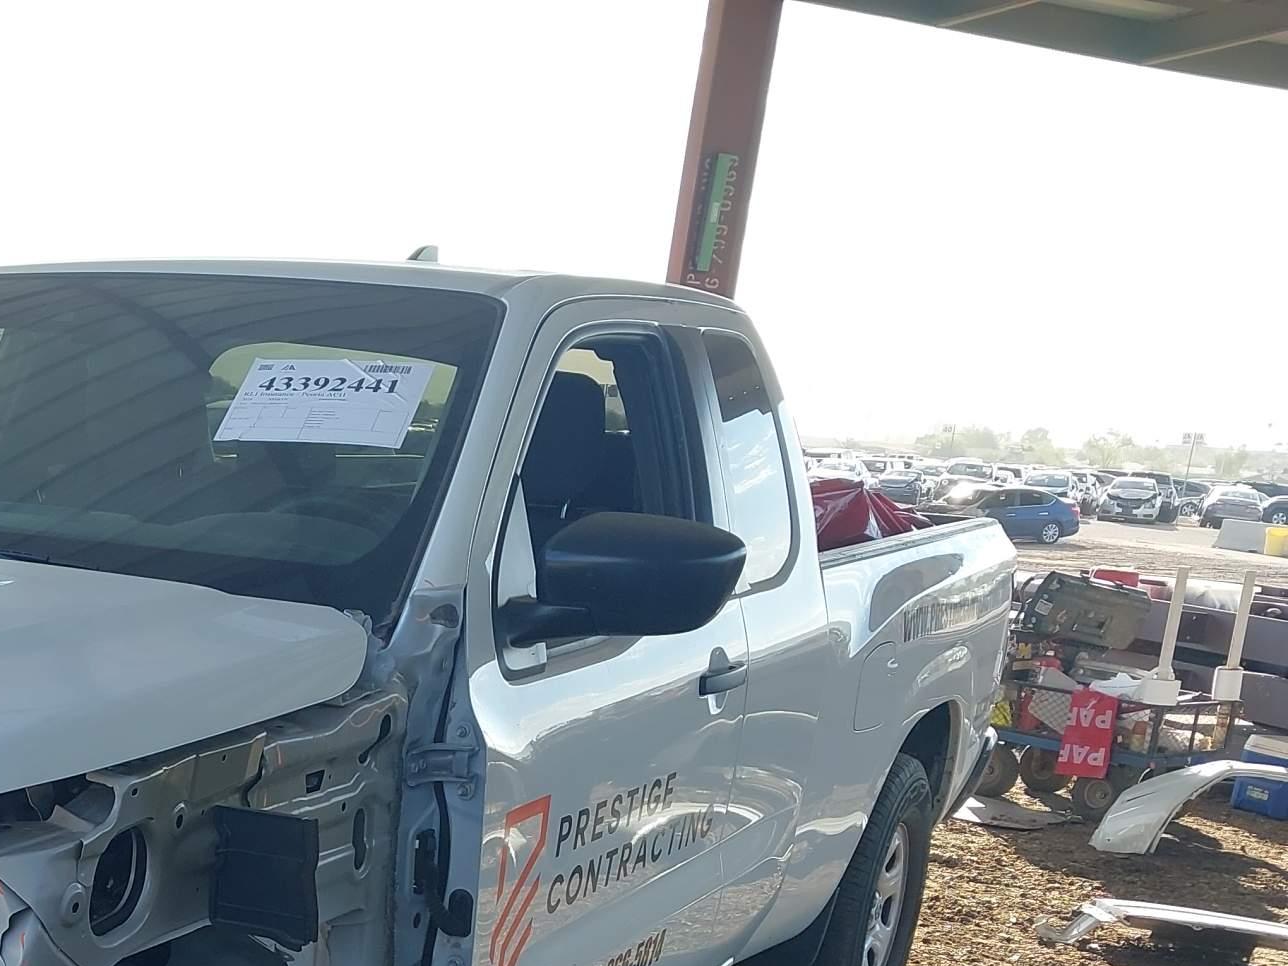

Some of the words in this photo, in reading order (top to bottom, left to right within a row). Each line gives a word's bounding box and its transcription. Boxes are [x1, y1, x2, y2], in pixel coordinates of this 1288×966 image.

[258, 376, 400, 394] 43392441
[555, 772, 677, 857] PRESTIGE
[546, 803, 713, 914] CONTRACTING
